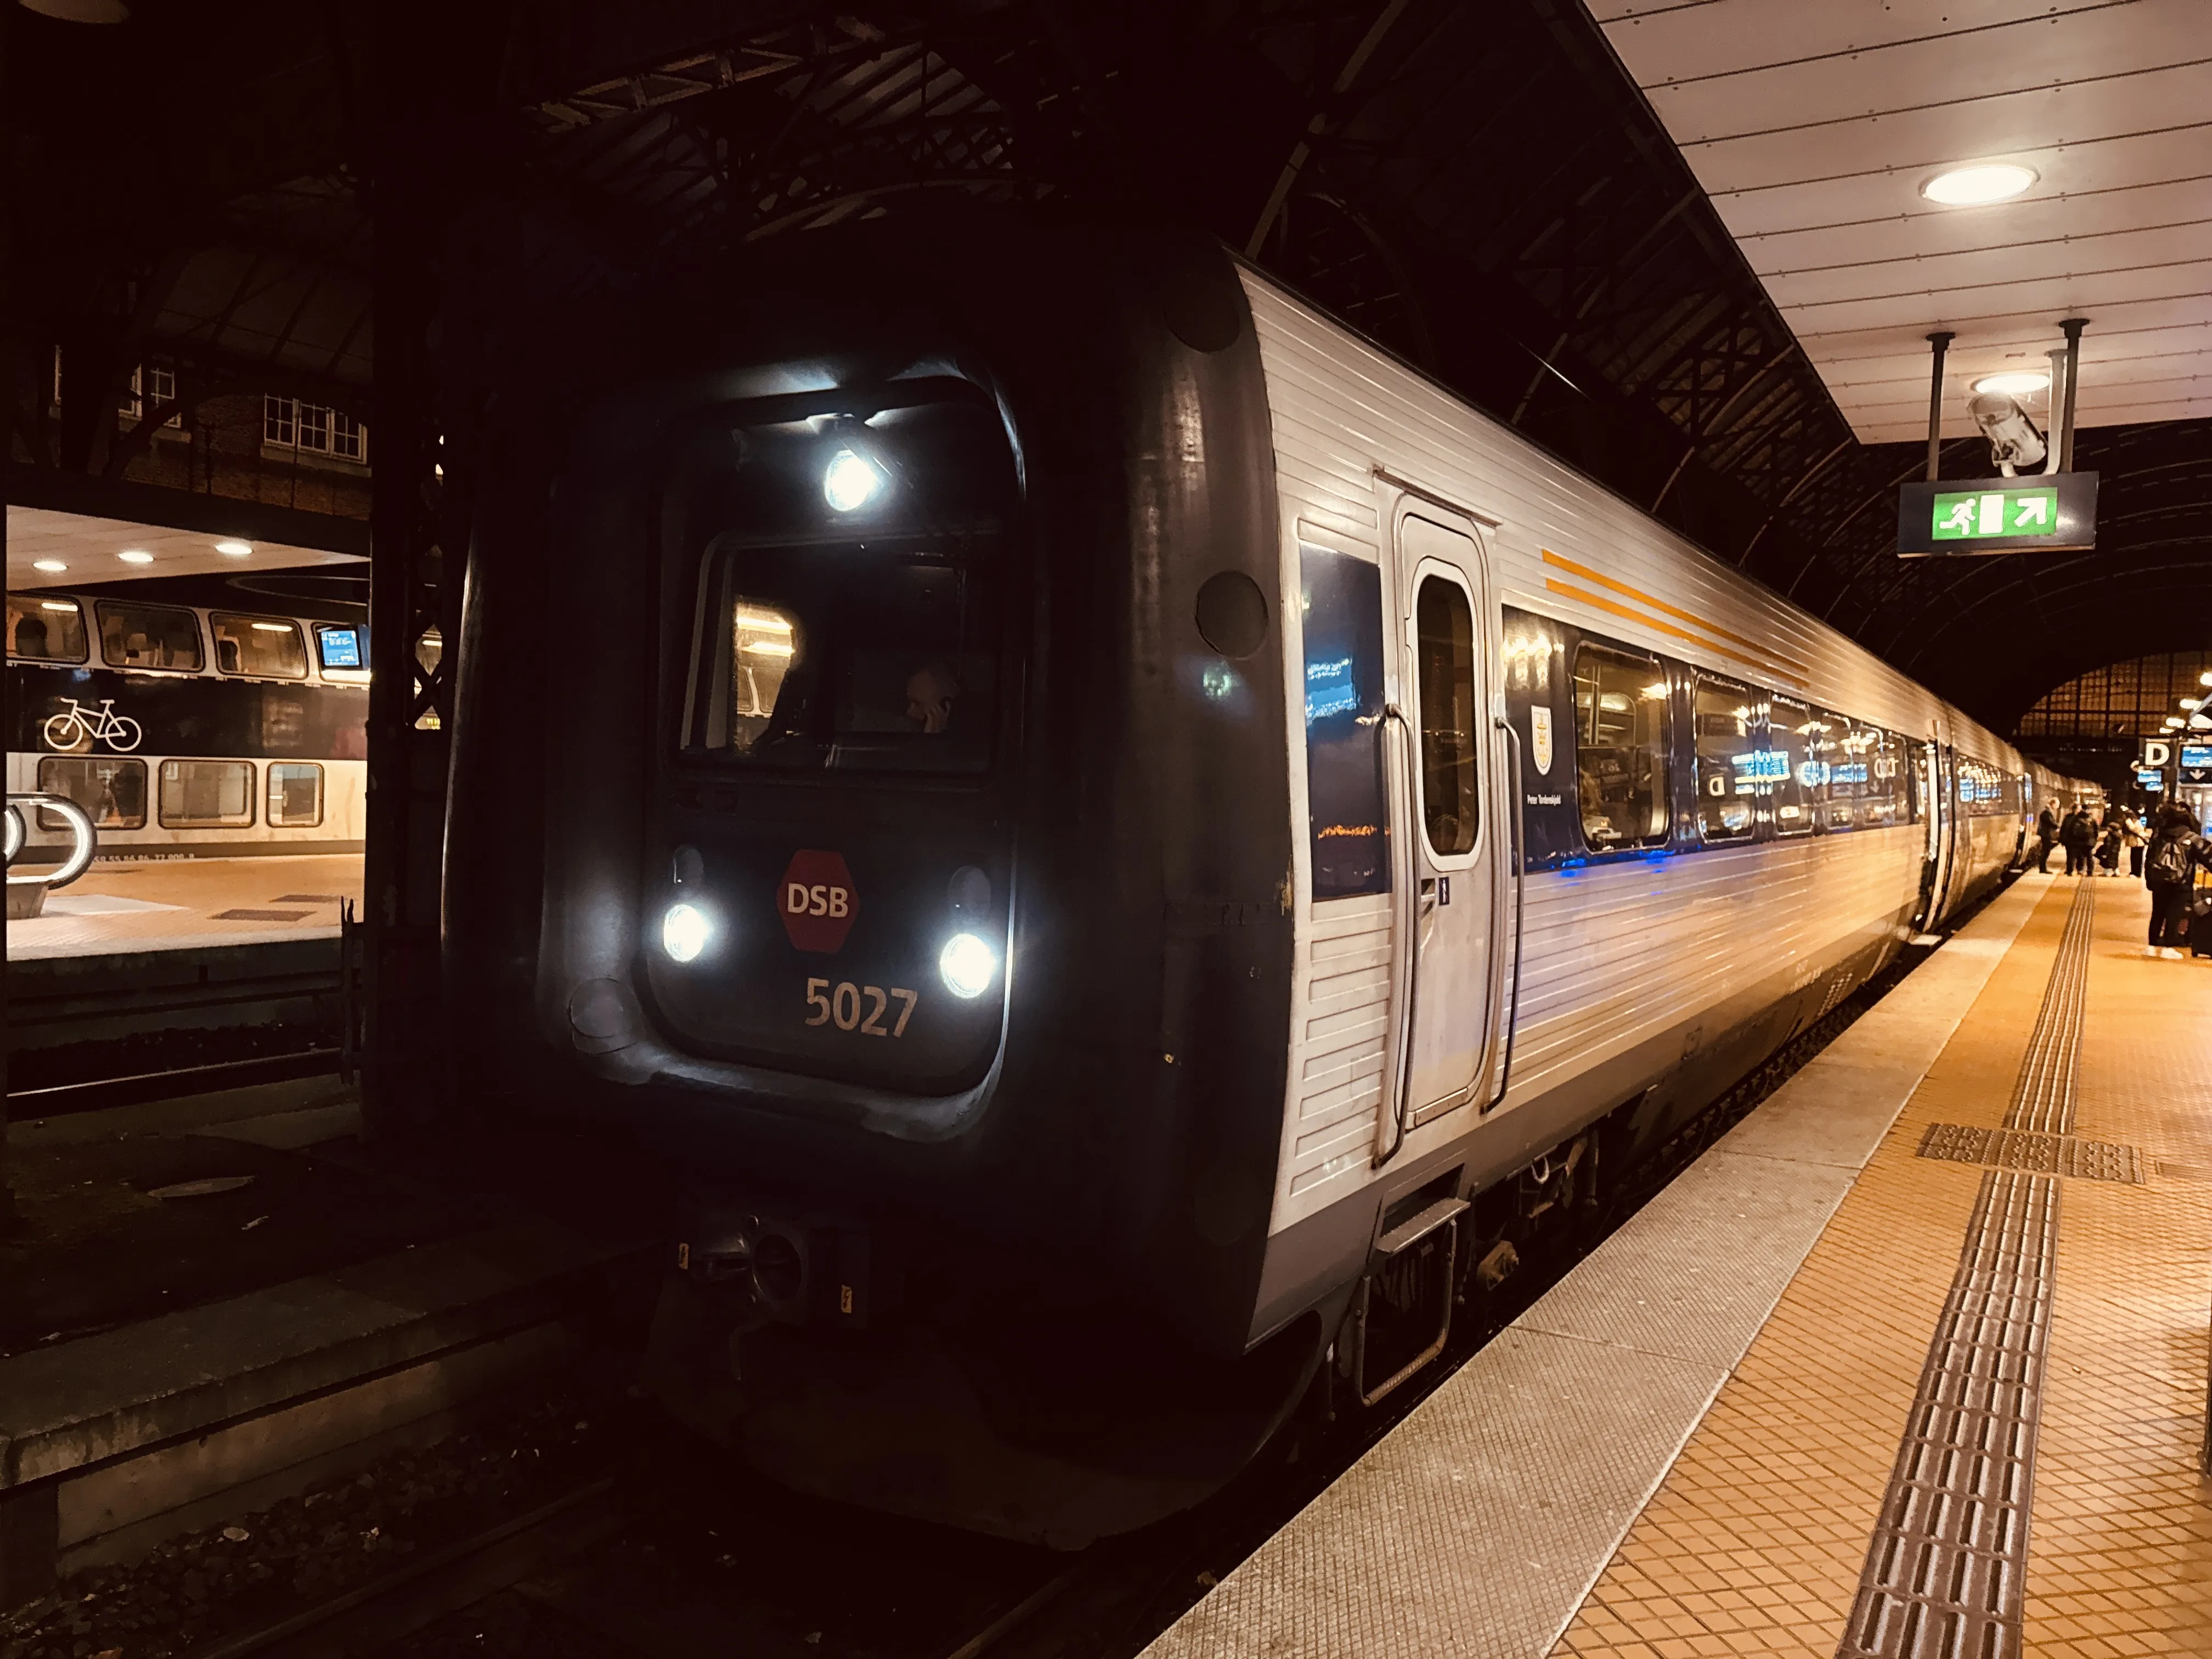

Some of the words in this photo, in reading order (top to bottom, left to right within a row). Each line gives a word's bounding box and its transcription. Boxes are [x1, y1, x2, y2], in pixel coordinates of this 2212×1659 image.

[2145, 743, 2170, 766] D
[787, 883, 849, 918] DSB
[805, 977, 918, 1038] 5027
